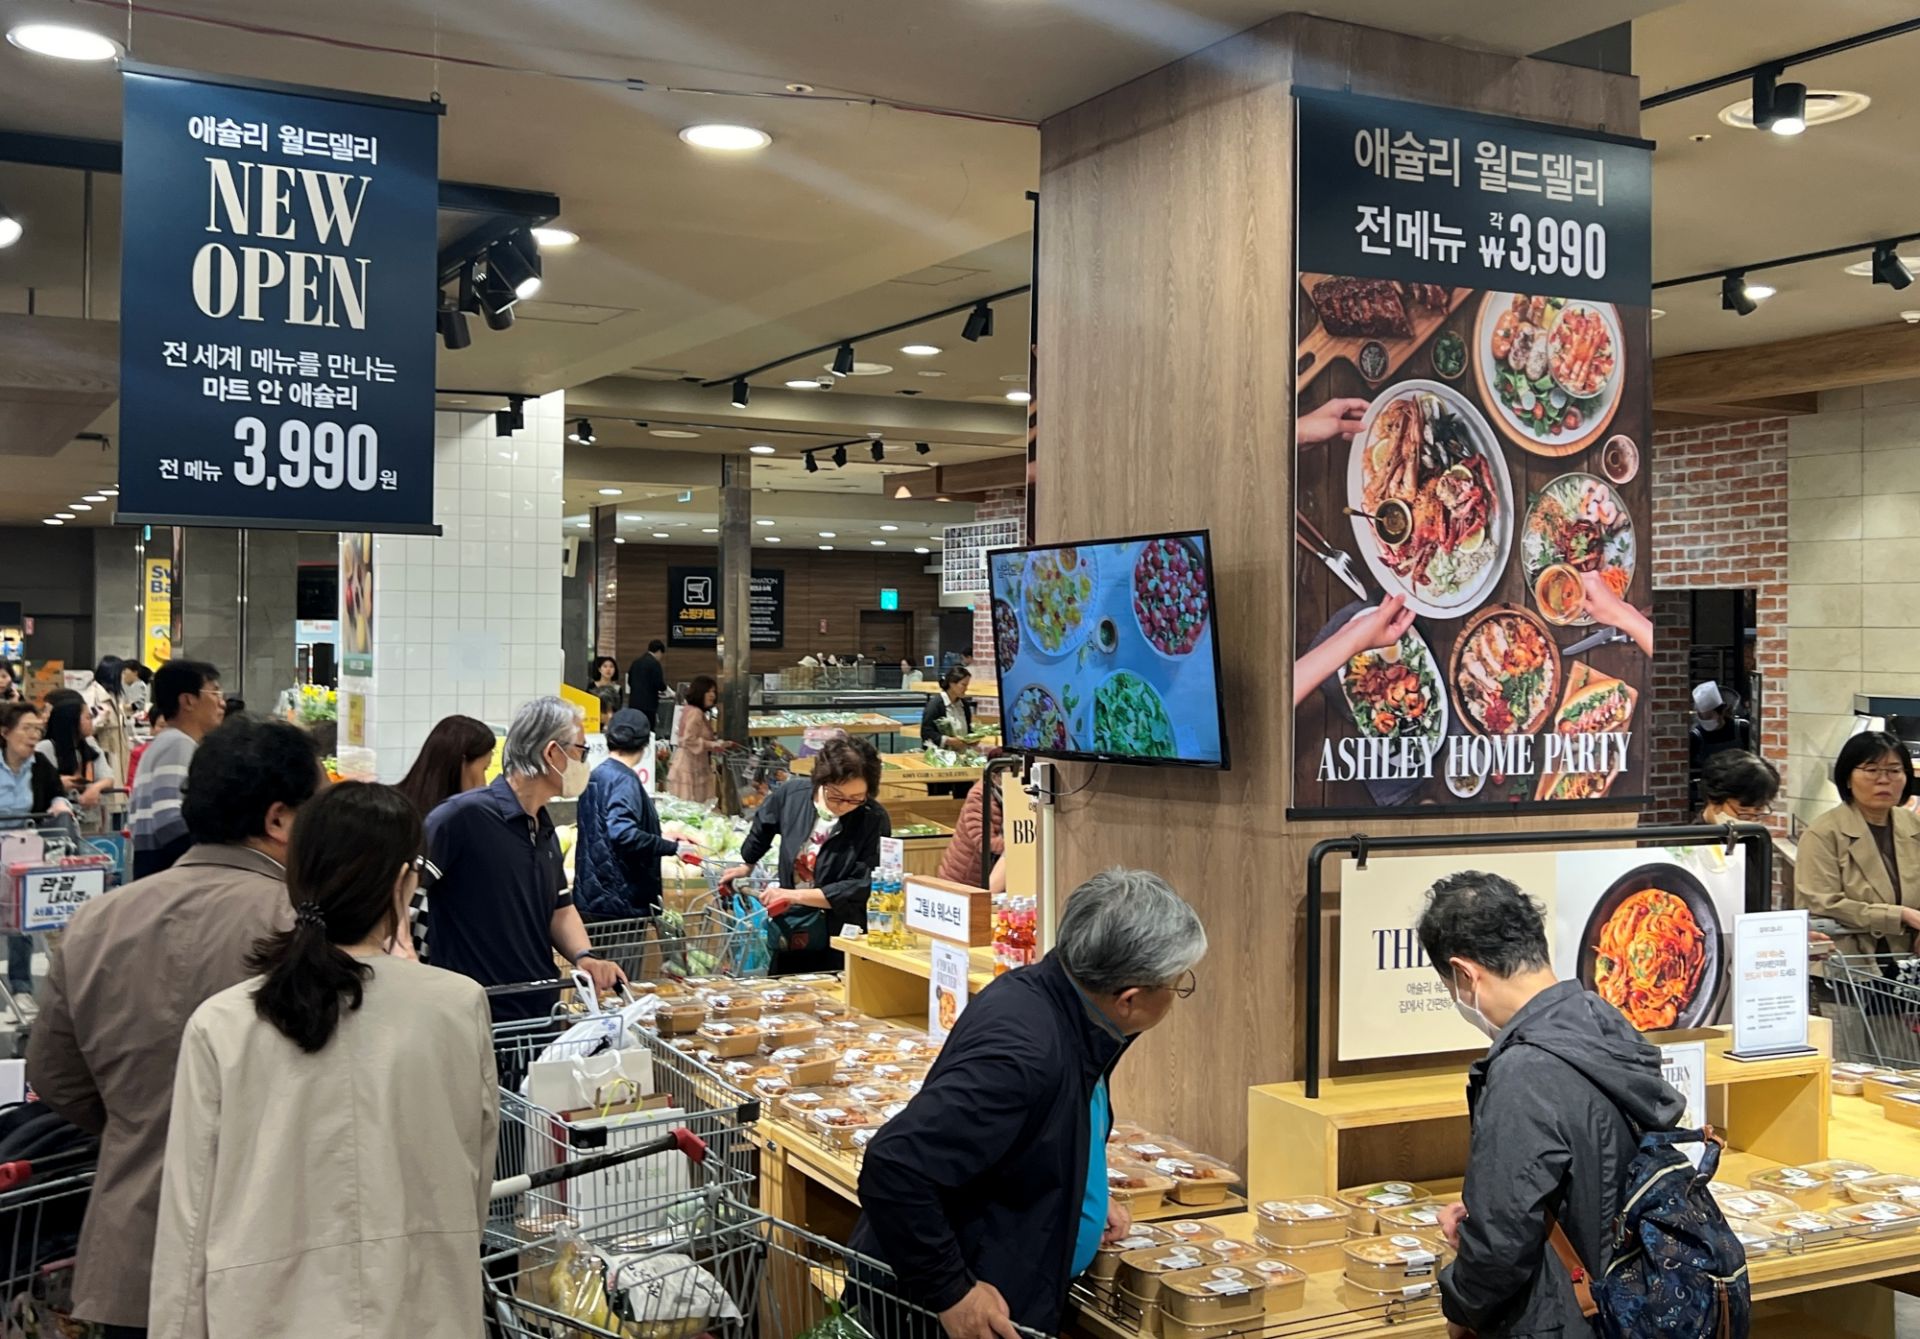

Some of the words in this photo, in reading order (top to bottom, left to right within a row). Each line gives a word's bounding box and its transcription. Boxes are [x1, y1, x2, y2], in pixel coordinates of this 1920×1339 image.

[188, 115, 269, 152] 애슐리
[278, 125, 378, 166] 월드델리
[1354, 127, 1461, 188] 애슐리
[1473, 140, 1605, 208] 월드델리
[203, 156, 373, 248] NEW
[1355, 204, 1467, 265] 전메뉴
[1488, 211, 1504, 231] 각
[191, 242, 372, 330] OPEN
[162, 341, 188, 370] 전
[193, 342, 243, 373] 세계
[250, 348, 323, 380] 메뉴를
[327, 354, 398, 383] 만나는
[202, 376, 252, 404] 마트
[258, 379, 283, 406] 안
[288, 381, 358, 411] 애슐리
[158, 458, 180, 482] 전
[184, 459, 223, 484] 메뉴
[1316, 736, 1438, 783] ASHLEY
[1447, 733, 1536, 779] HOME
[1542, 731, 1633, 775] PARTY
[1013, 819, 1036, 844] BB
[1399, 999, 1424, 1014] 집에서
[1407, 982, 1431, 995] 애슐리
